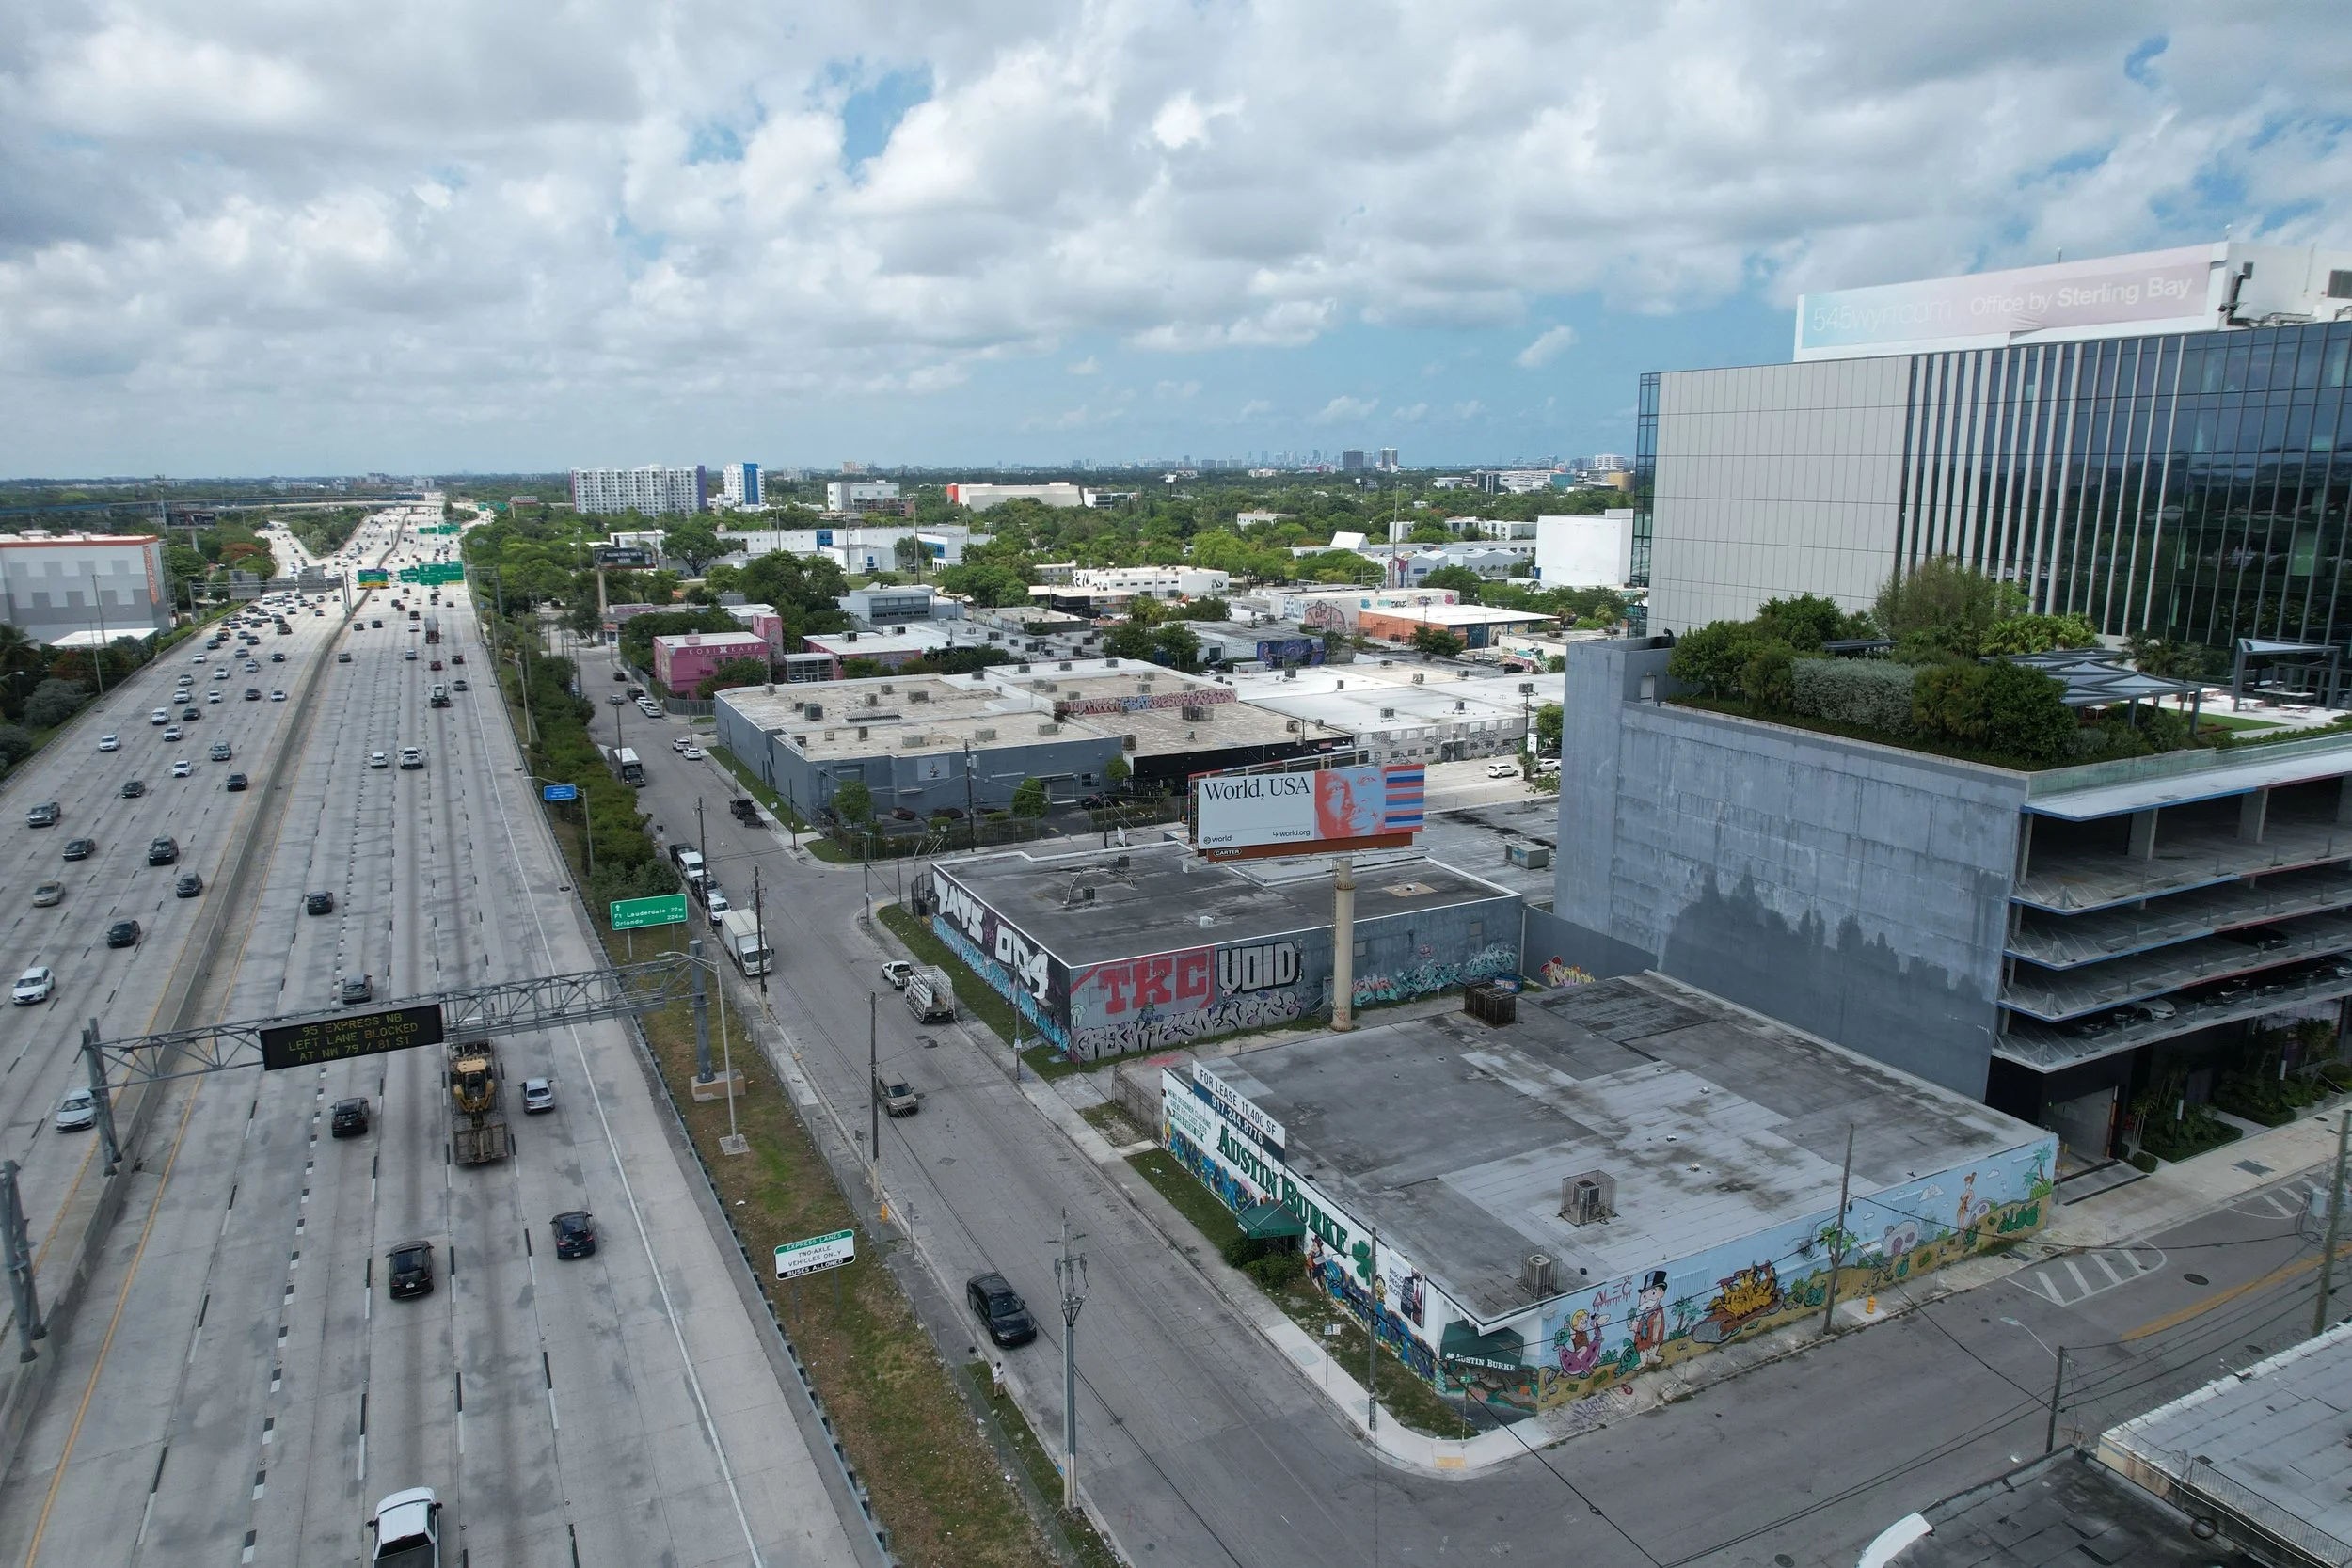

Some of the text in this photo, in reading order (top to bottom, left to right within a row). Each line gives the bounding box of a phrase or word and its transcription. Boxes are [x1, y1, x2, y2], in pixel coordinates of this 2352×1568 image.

[1970, 296, 2024, 316] Office
[2029, 293, 2053, 313] by
[2057, 282, 2139, 308] Sterling
[2146, 277, 2193, 302] Bay
[145, 548, 157, 594] STORAGE
[689, 644, 760, 656] KOBI KARP
[1204, 776, 1311, 800] World, USA
[1211, 834, 1232, 843] world
[1279, 829, 1311, 838] world.org
[614, 918, 644, 927] Orlando
[627, 909, 666, 918] Lauderdale
[1098, 953, 1208, 1015] TKC
[1217, 941, 1300, 994] VOID
[302, 1013, 403, 1036] 95 EXPRESS NB
[288, 1022, 418, 1052] LEFT LANE BLOCKED
[299, 1051, 314, 1062] AT
[322, 1047, 339, 1058] NW
[345, 1043, 359, 1054] 79
[378, 1039, 390, 1049] 81
[396, 1036, 411, 1047] ST
[1200, 1069, 1277, 1136] FOR LEASE 11,400 SF
[1211, 1094, 1263, 1145] 917.244.8776
[1216, 1124, 1279, 1199] AUSTIN
[1281, 1173, 1348, 1259] BURKE
[786, 1232, 842, 1251] EXPRESS LANES
[798, 1245, 832, 1258] TWO-AXLE
[787, 1250, 842, 1267] VEHICLES ONLY
[787, 1259, 844, 1277] BUSES ALLOWED
[1455, 1354, 1516, 1371] AUSTIN BURKE
